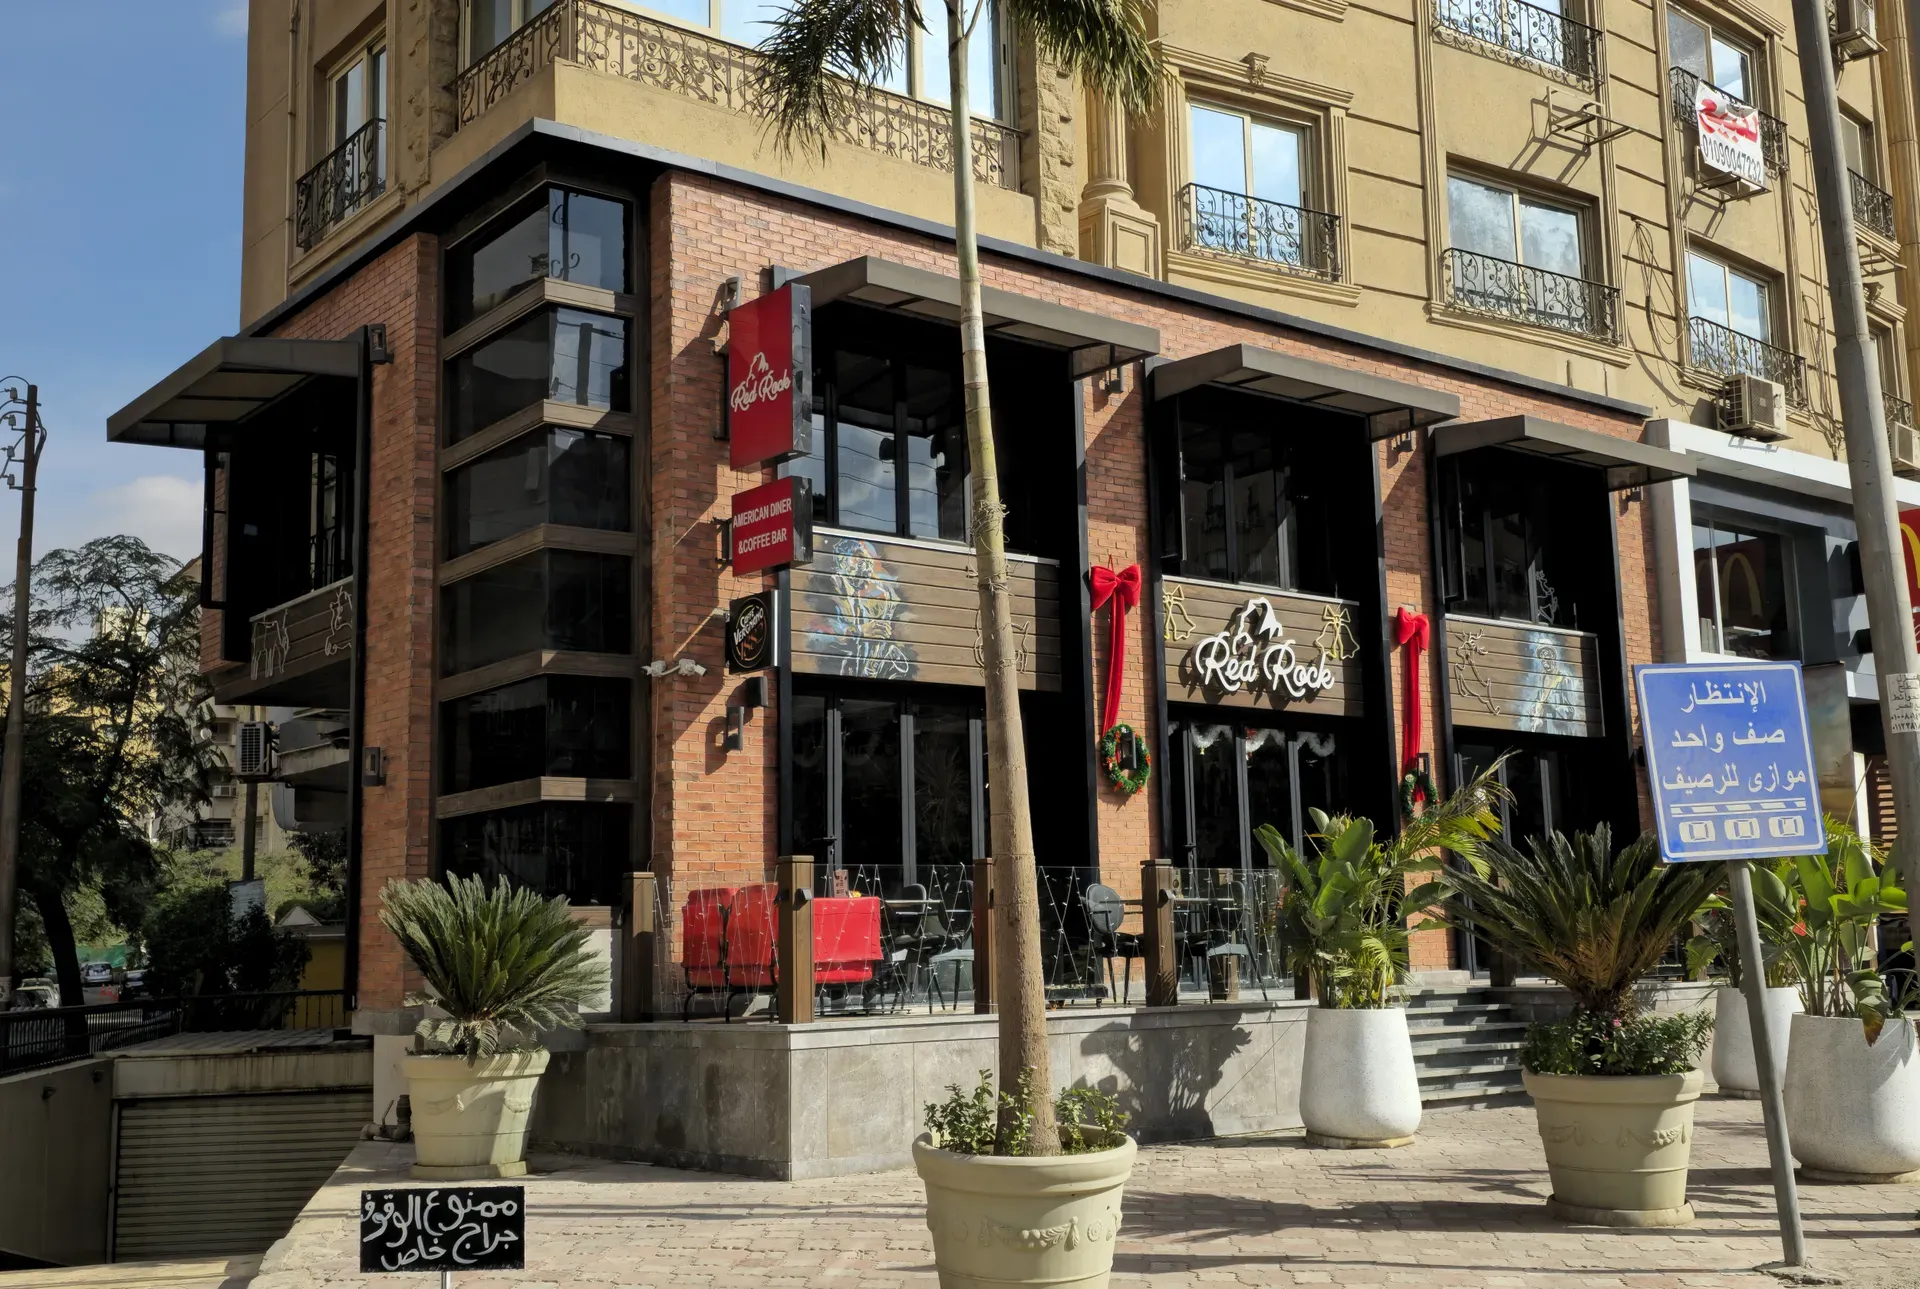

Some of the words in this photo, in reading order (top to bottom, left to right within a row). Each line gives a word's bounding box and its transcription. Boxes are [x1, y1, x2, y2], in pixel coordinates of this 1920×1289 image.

[730, 381, 758, 413] Red
[758, 368, 792, 402] Rock
[733, 504, 770, 529] AMERICAN
[770, 498, 793, 517] DINER
[738, 532, 771, 555] &COFFEE
[771, 527, 787, 545] BAR
[1195, 631, 1258, 692] Red
[1263, 639, 1336, 698] Rock
[1681, 679, 1767, 714] الإنتظار
[1671, 723, 1725, 754] واحد
[1733, 721, 1786, 746] صف
[1662, 762, 1740, 796] للرصيف
[361, 1193, 422, 1248] الوقوف
[423, 1190, 518, 1237] ممنوع
[380, 1234, 448, 1271] خاص
[452, 1221, 519, 1265] جراج
